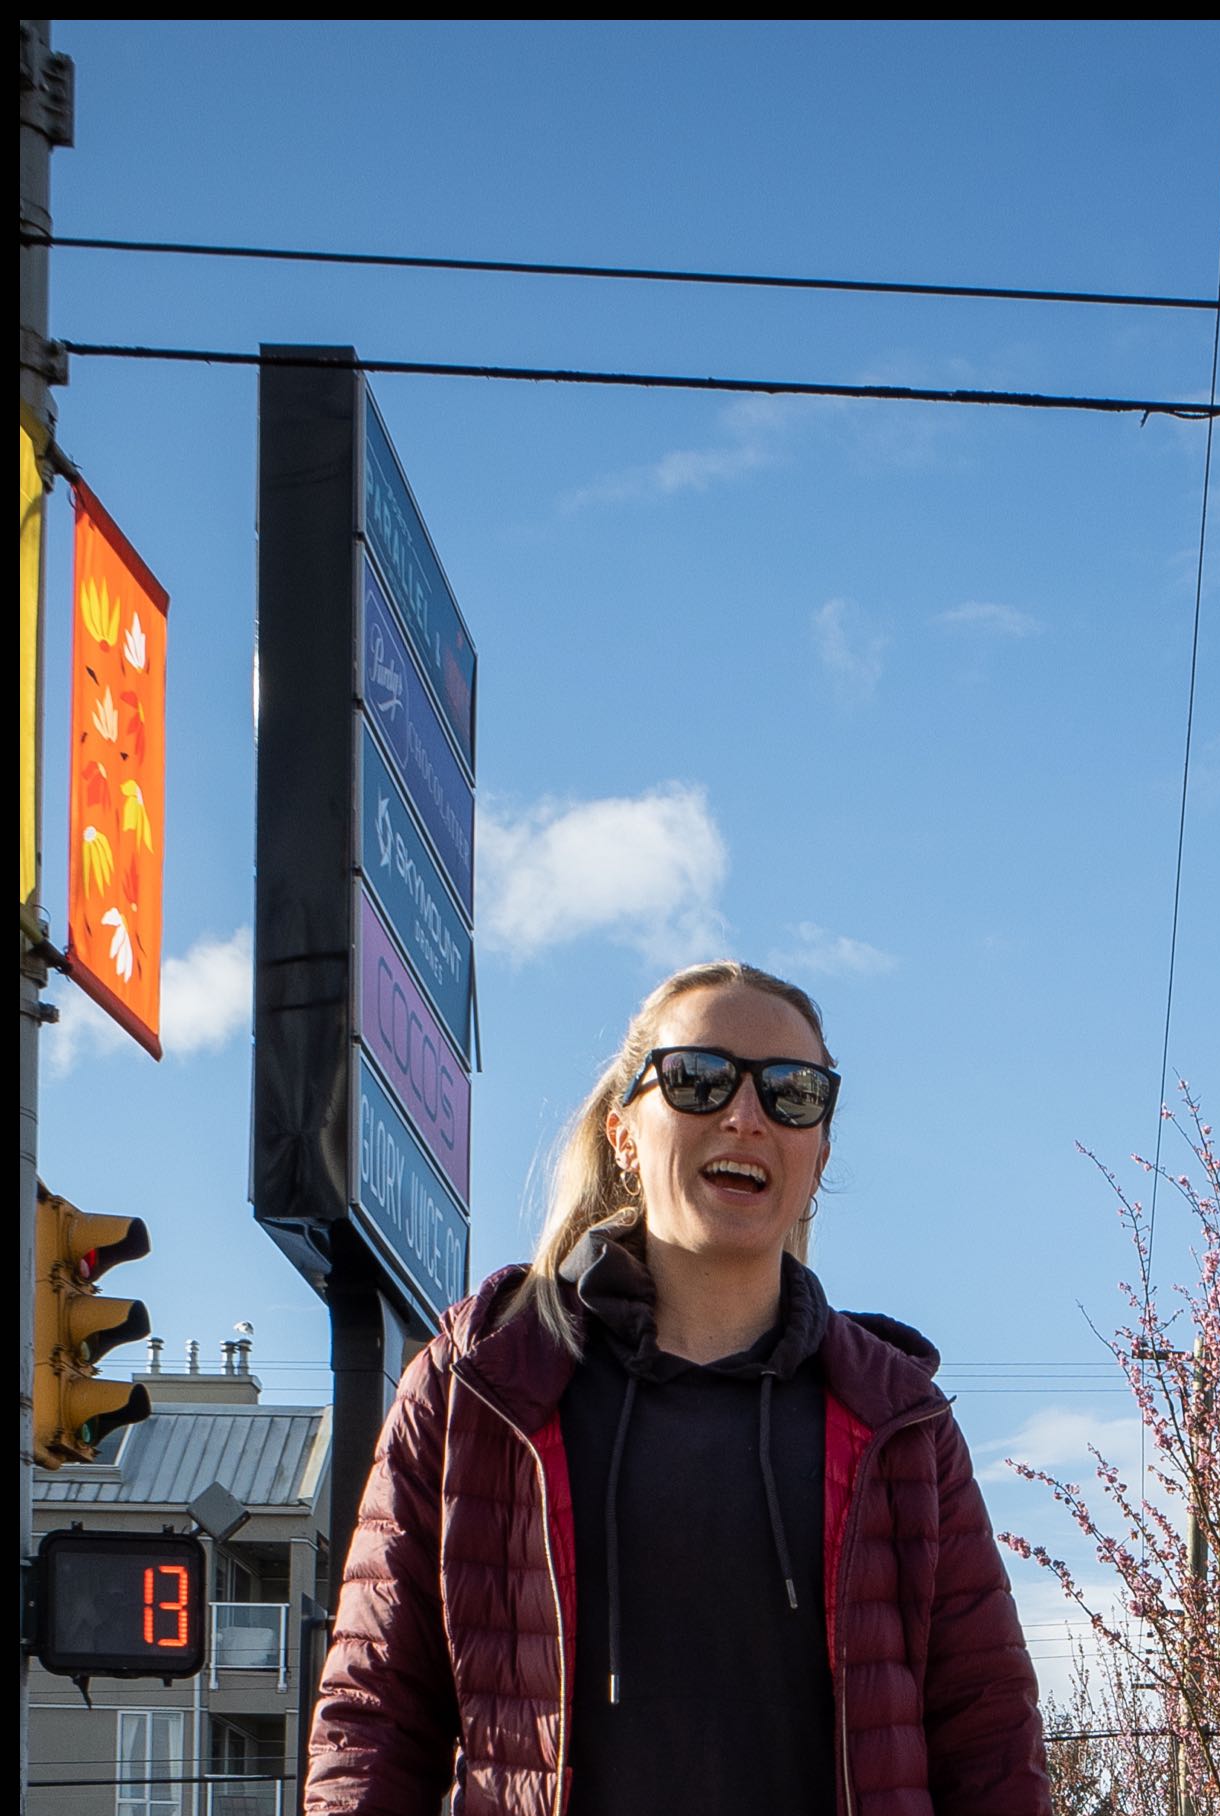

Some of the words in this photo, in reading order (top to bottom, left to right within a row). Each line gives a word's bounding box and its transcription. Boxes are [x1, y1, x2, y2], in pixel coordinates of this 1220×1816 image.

[366, 458, 431, 648] PARALLEL
[408, 721, 471, 870] CHOCOLATIER
[396, 832, 462, 982] SKYMOUNT
[414, 920, 443, 986] DRONES
[378, 955, 455, 1151] COCO'S
[361, 1094, 404, 1232] GLORY
[405, 1171, 443, 1291] JUICE
[144, 1565, 188, 1647] 13
